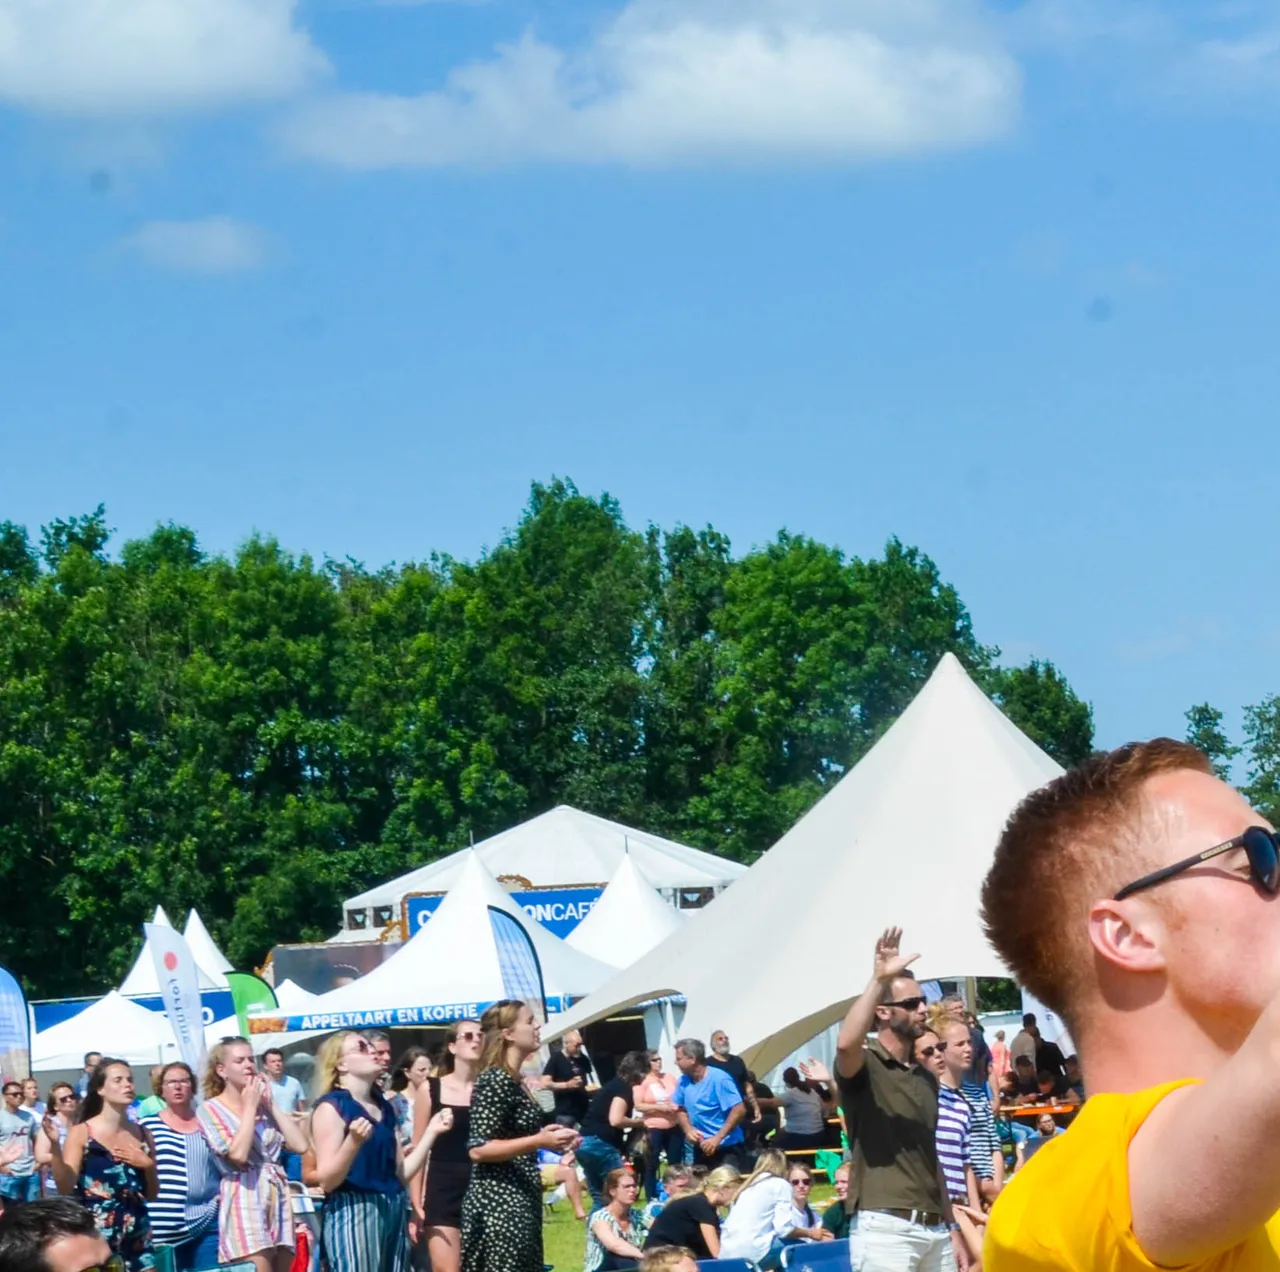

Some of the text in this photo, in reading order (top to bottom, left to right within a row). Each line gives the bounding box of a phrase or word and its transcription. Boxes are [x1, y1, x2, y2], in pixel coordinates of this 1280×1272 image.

[301, 1003, 478, 1030] APPELTAART EN KOFFIE
